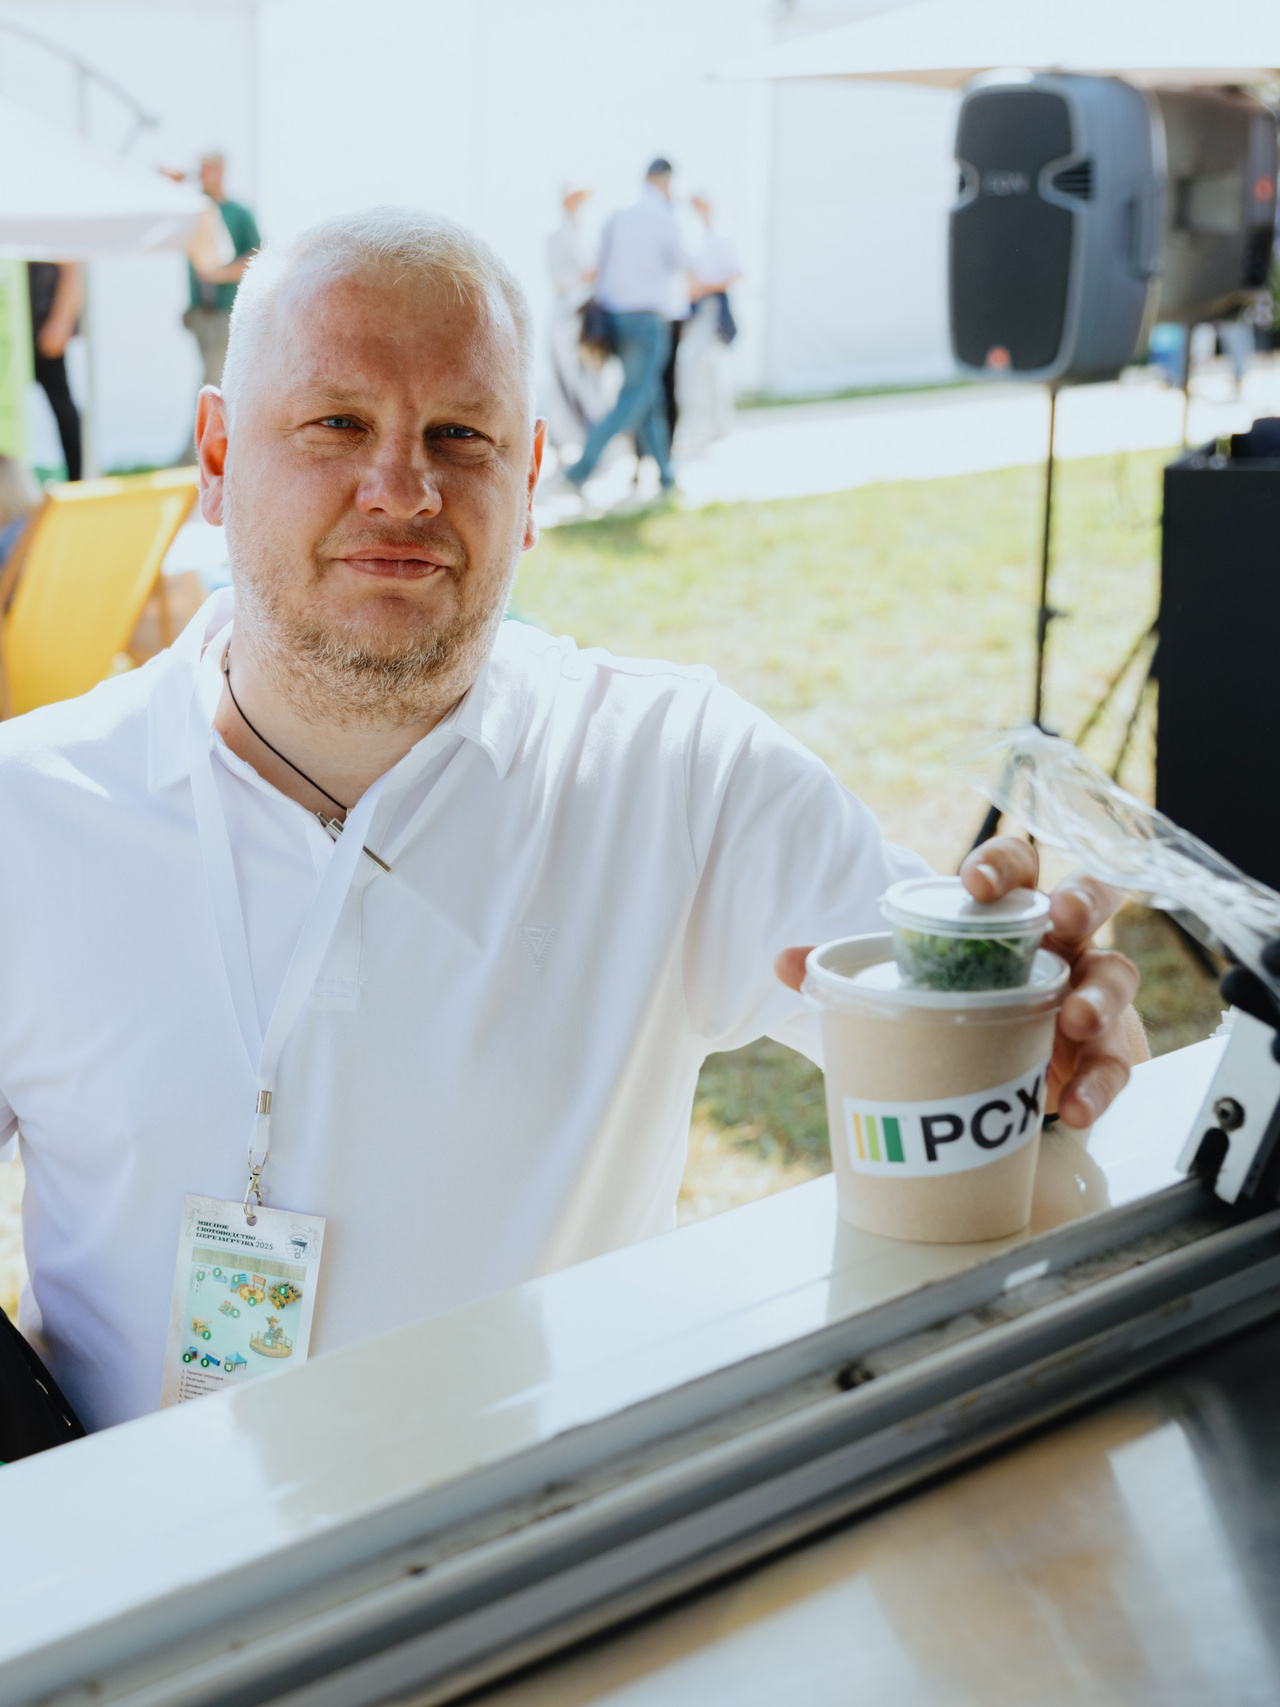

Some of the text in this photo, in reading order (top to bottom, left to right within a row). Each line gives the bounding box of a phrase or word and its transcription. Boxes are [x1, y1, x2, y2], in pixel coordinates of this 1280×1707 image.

[197, 1220, 230, 1230] МЯСНОЕ
[195, 1232, 274, 1250] ПЕРЕЗАГРУЗКА 2025
[196, 1226, 256, 1241] СКОТОВОДСТВО
